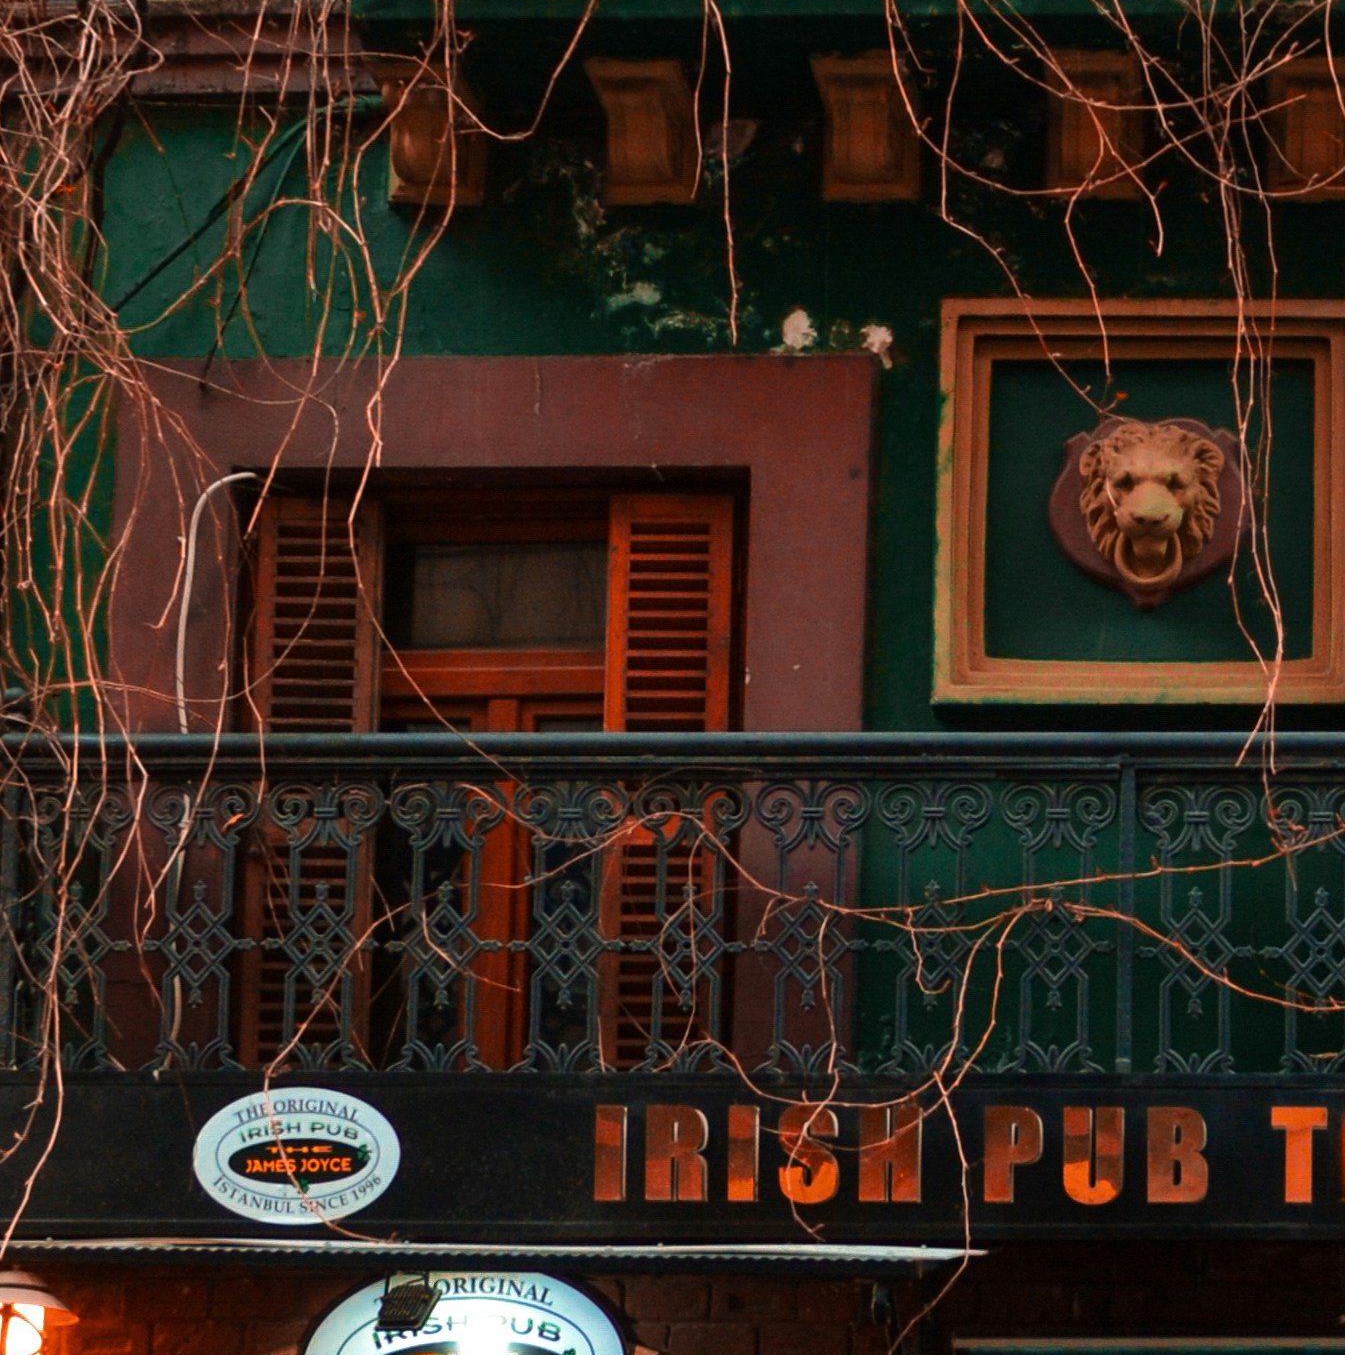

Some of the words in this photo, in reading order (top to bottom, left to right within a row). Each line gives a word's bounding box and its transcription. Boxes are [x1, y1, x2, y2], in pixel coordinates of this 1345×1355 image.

[233, 1103, 269, 1126] THE
[273, 1098, 360, 1124] ORIGINAL
[240, 1120, 301, 1143] IRISH
[310, 1121, 359, 1140] PUB
[246, 1157, 297, 1173] JAMES
[300, 1157, 352, 1172] JOYCE
[594, 1105, 922, 1204] IRISH
[983, 1106, 1209, 1205] PUB
[213, 1175, 295, 1214] ISTANBUL
[299, 1195, 349, 1213] SINCE
[351, 1175, 382, 1202] 1996
[432, 1275, 553, 1306] ORIGINAL
